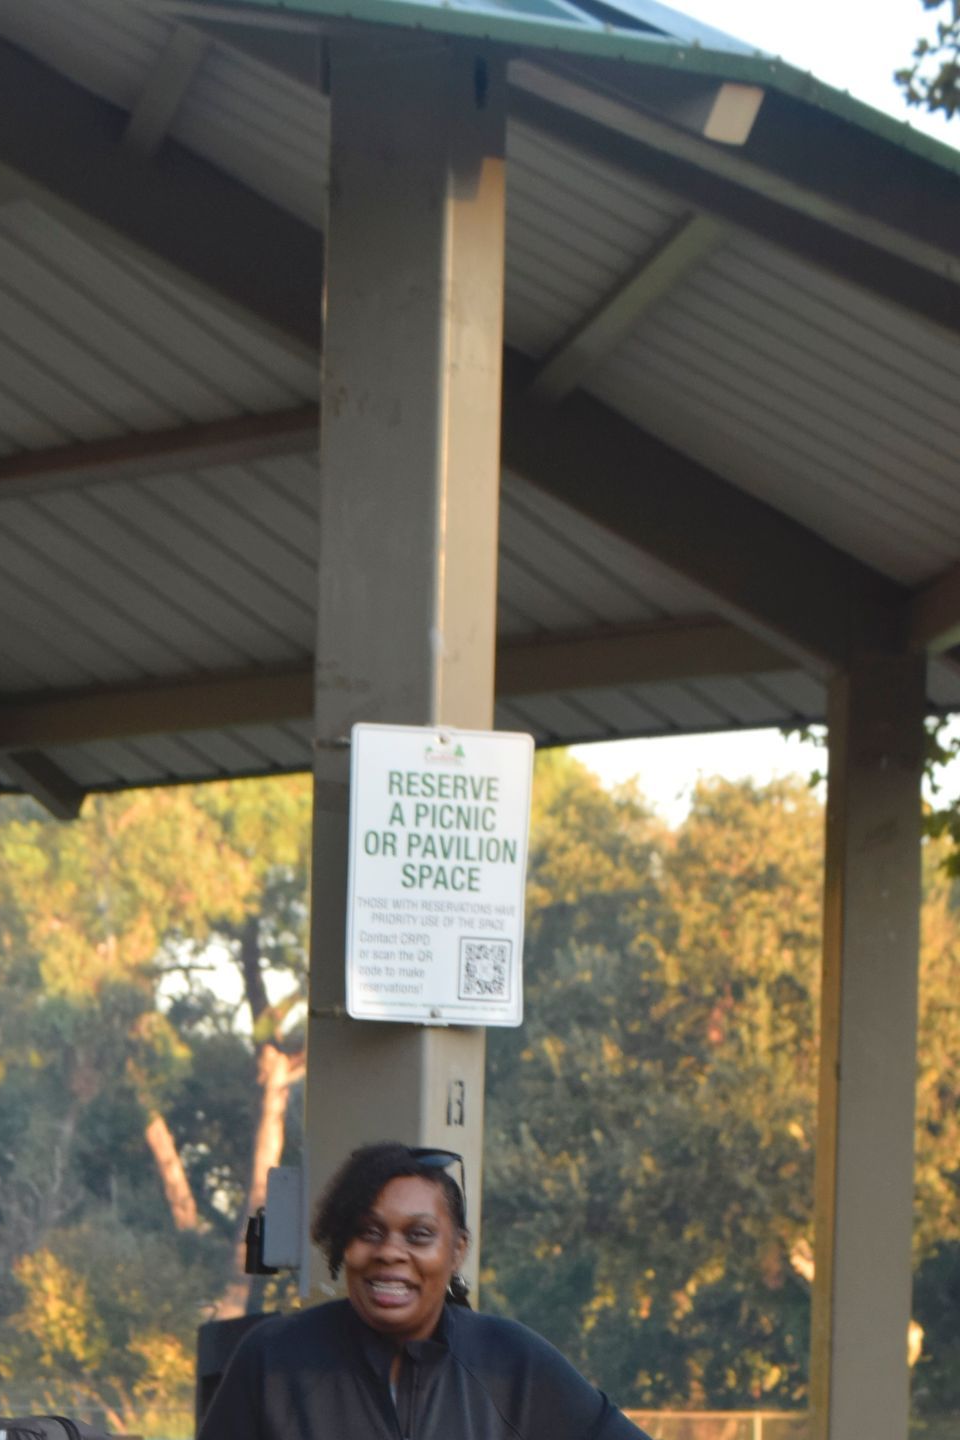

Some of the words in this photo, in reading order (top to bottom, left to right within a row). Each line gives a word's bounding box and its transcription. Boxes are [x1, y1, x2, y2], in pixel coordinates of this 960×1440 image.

[388, 770, 500, 802] RESERVE
[388, 801, 405, 827] A
[414, 802, 497, 832] PICNIC
[364, 830, 398, 857] OR
[407, 832, 517, 864] PAVILION
[401, 863, 481, 892] SPACE
[357, 897, 388, 911] THOSE
[392, 898, 419, 911] WITH
[421, 900, 492, 915] RESERVATIONS
[494, 904, 516, 917] HAVE
[371, 912, 417, 927] PRIORITY
[420, 915, 440, 928] USE
[442, 916, 454, 928] OF
[457, 917, 475, 929] THE
[478, 918, 505, 931] SPACE
[359, 931, 398, 945] Contact
[400, 933, 431, 945] CRPD
[358, 949, 369, 960] or
[372, 950, 395, 960] scan
[398, 949, 414, 961] the
[417, 950, 433, 963] QR
[358, 965, 382, 977] code
[383, 966, 395, 978] to
[398, 966, 425, 978] make
